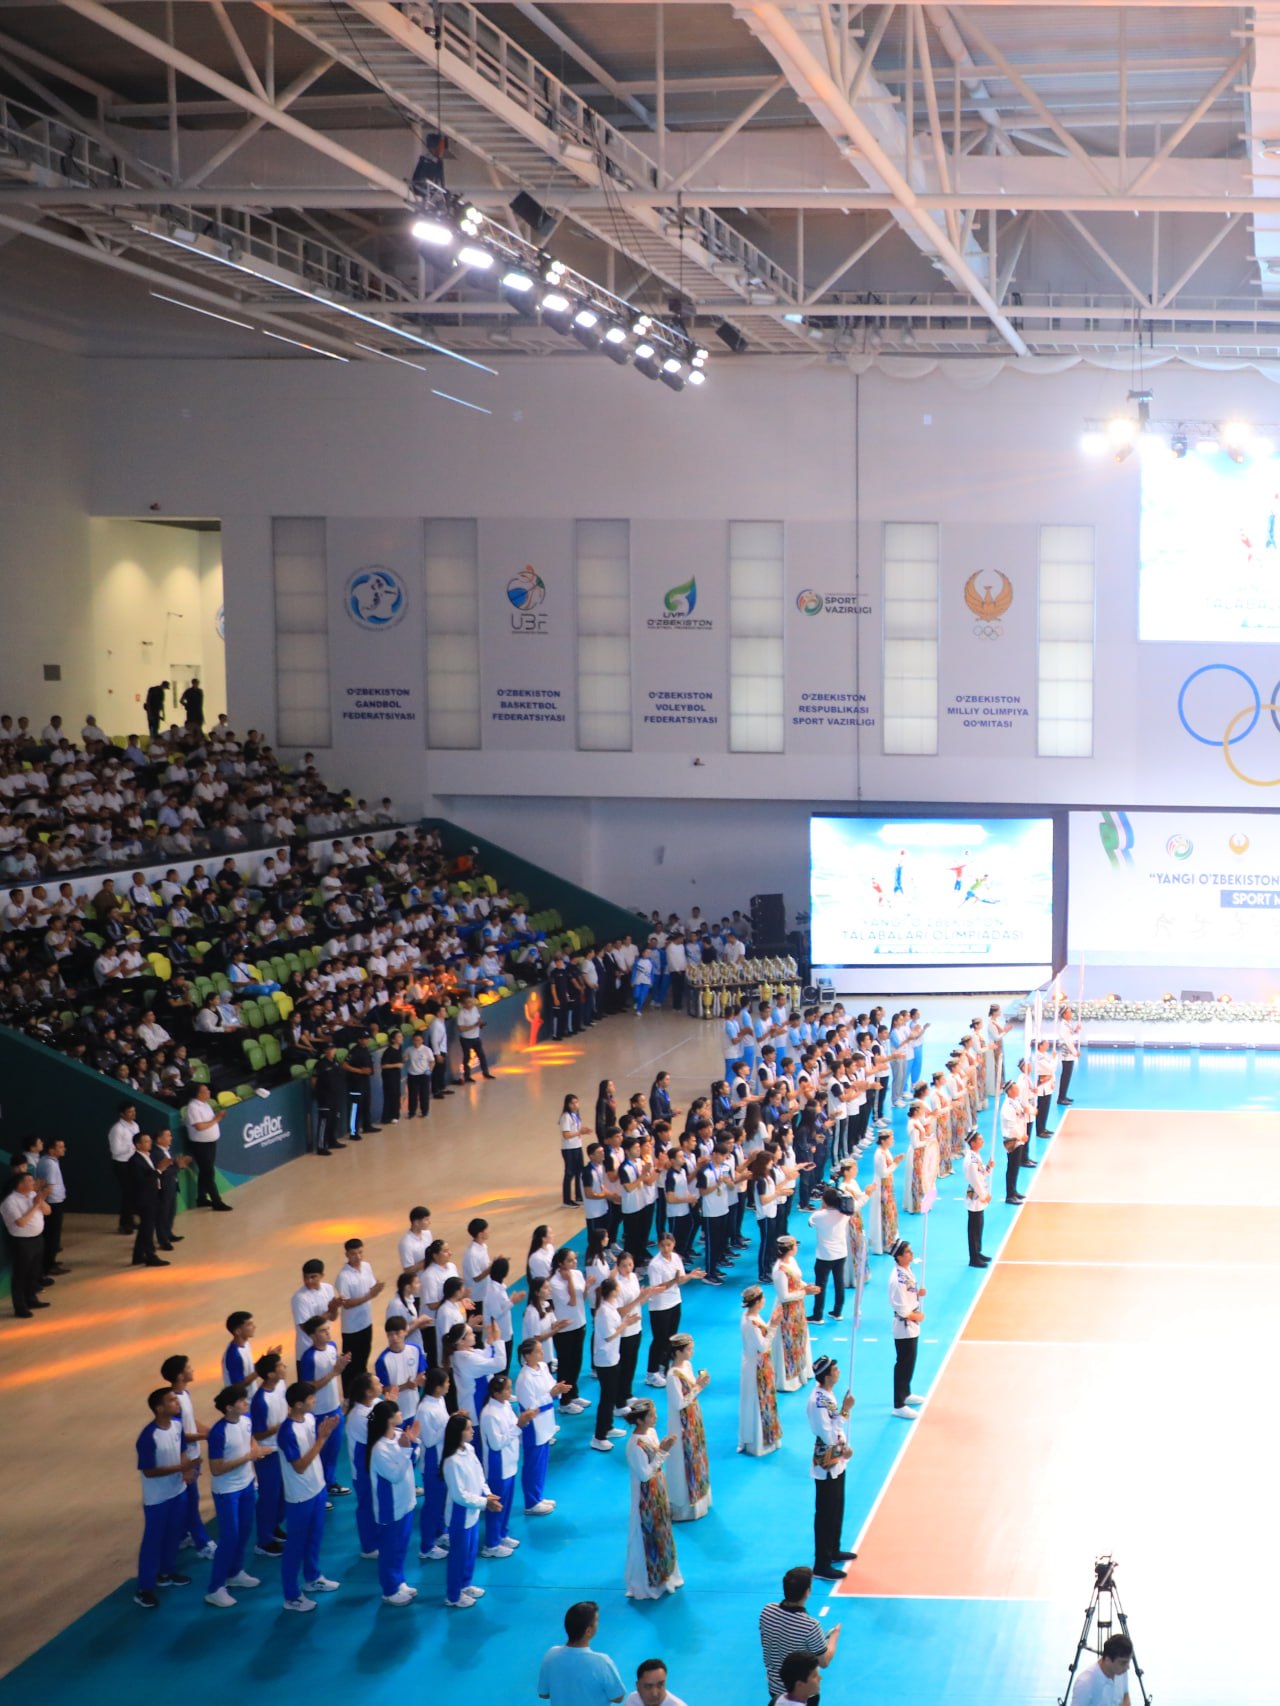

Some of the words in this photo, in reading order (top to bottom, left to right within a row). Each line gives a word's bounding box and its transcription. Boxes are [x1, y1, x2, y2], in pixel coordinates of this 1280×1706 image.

[825, 606, 872, 614] VAZIRLIGI
[511, 613, 548, 630] UBF
[347, 688, 410, 697] O'ZBEKISTON
[497, 689, 560, 698] O'ZBEKISTON
[649, 691, 713, 700] O'ZBEKISTON
[801, 693, 866, 702] O'ZBEKISTON
[955, 695, 1021, 703] O'ZBEKISTON
[355, 700, 402, 708] GANDBOL
[500, 701, 557, 710] BASKETBOL
[655, 703, 706, 712] VOLEYBOL
[799, 705, 869, 714] RESPUBLIKASI
[947, 707, 980, 715] MILLIY
[983, 708, 1029, 716] OLIMPIYA
[342, 712, 416, 720] FEDERATSIYASI
[492, 713, 566, 722] FEDERATSIYASI
[644, 715, 718, 724] FEDERATSIYASI
[792, 717, 824, 726] SPORT
[827, 718, 875, 726] VAZIRLIGI
[963, 720, 1013, 728] QO'MITASI
[1199, 874, 1280, 886] O'ZBEKISTON
[1232, 892, 1271, 905] SPORT
[243, 1115, 282, 1142] Gerflor
